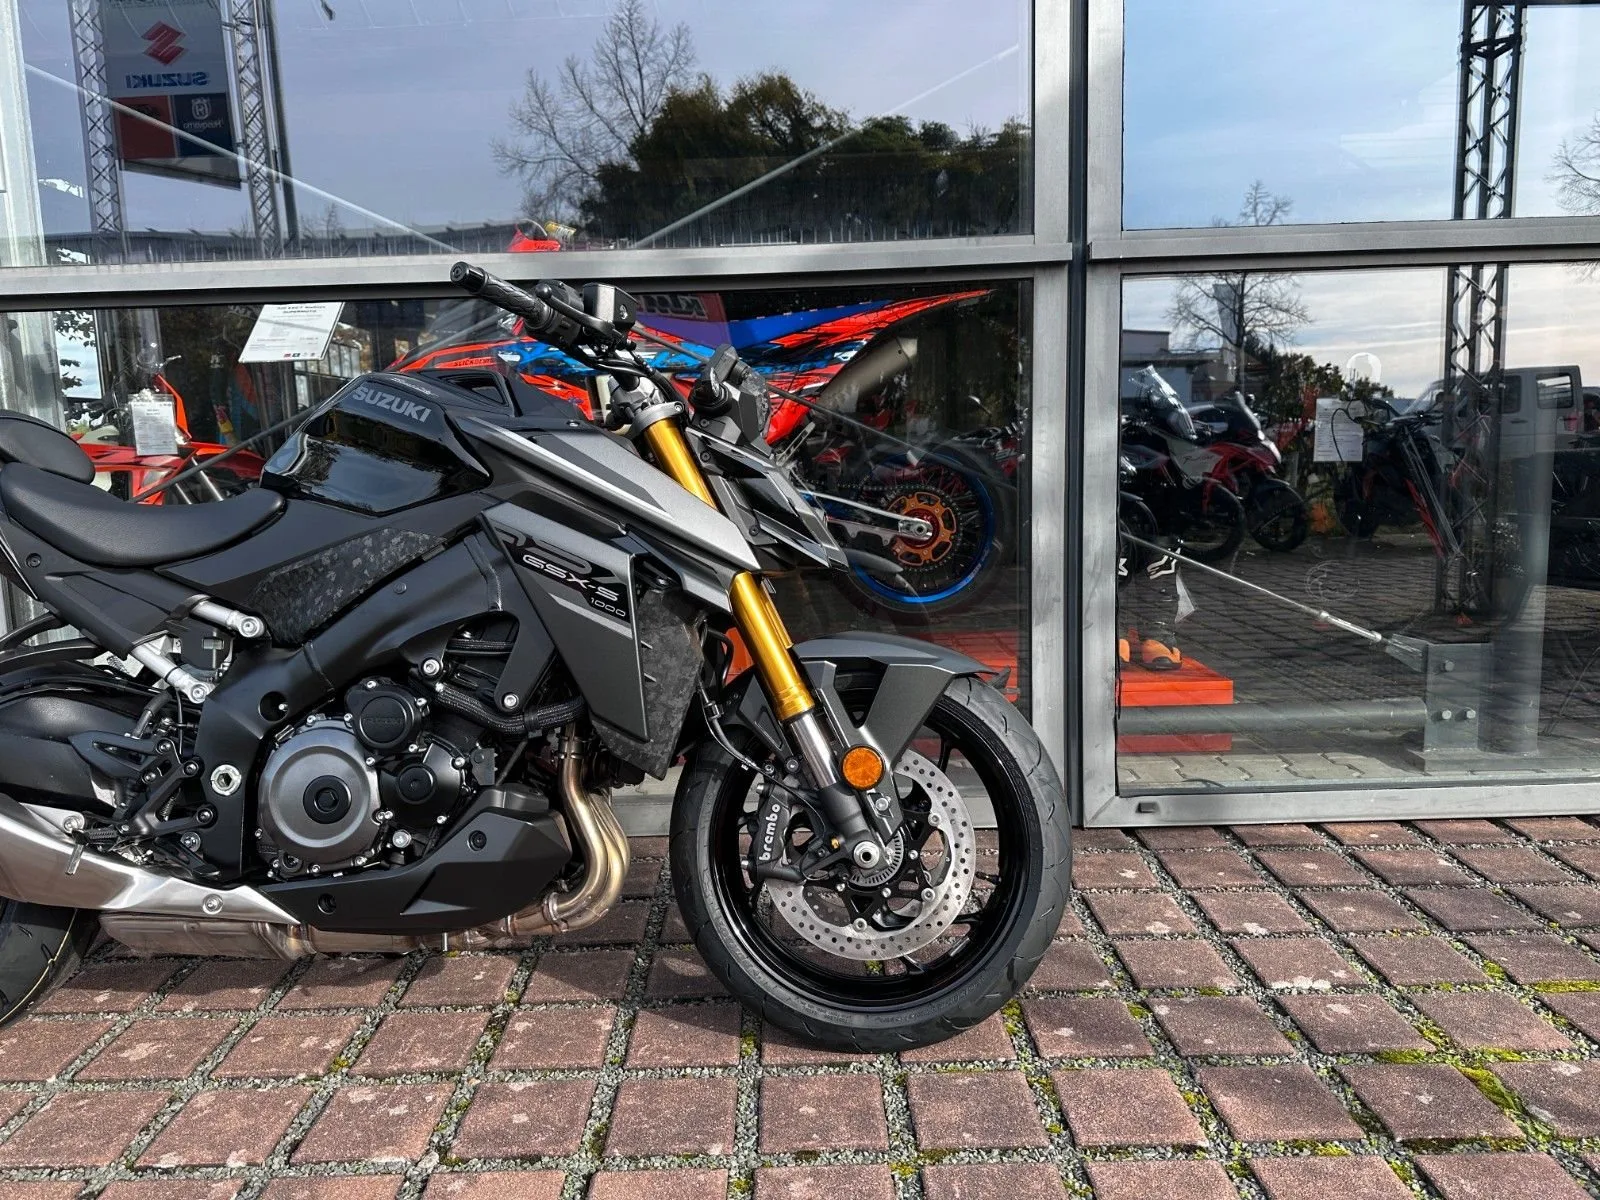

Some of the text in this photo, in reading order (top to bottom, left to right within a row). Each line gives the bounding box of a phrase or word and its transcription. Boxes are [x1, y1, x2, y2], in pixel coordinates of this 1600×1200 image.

[352, 383, 432, 423] SUZUKI
[522, 554, 620, 602] GSX-S
[590, 597, 626, 617] 1000
[759, 804, 780, 860] brembo
